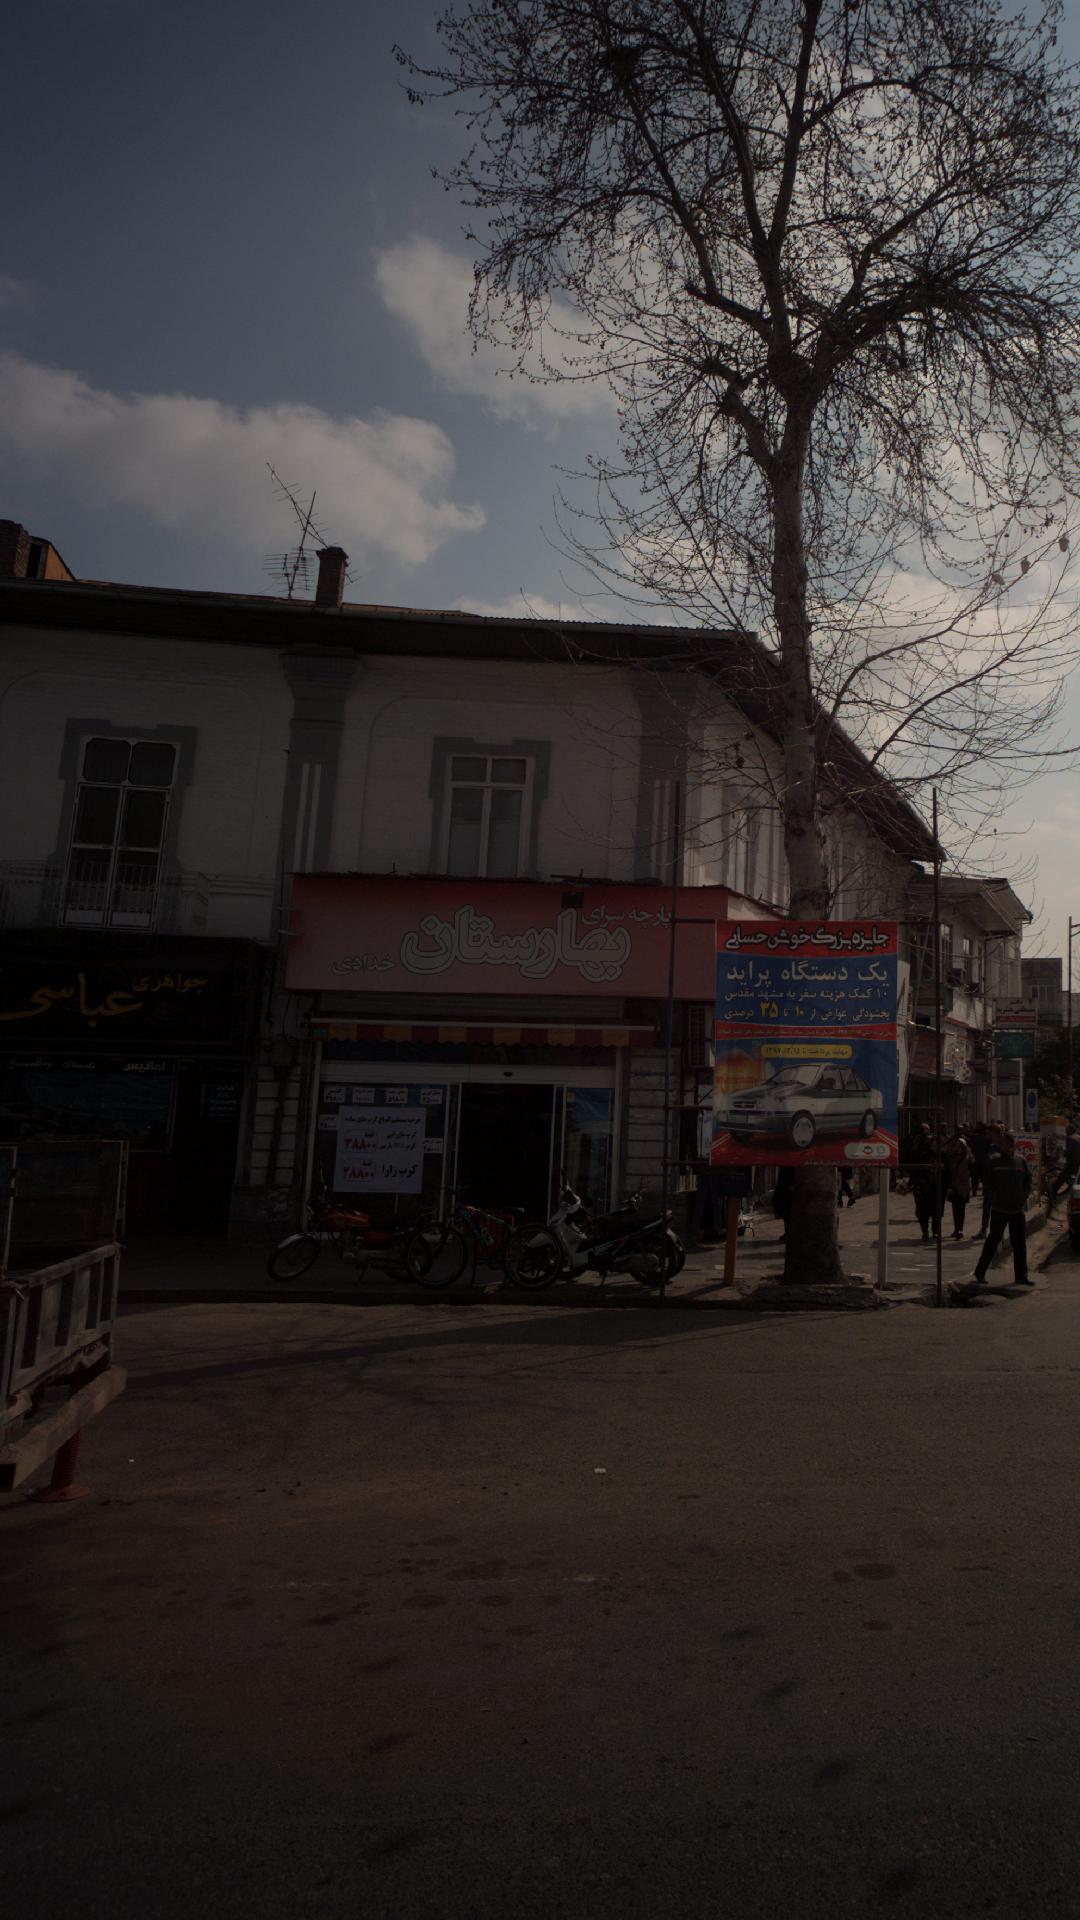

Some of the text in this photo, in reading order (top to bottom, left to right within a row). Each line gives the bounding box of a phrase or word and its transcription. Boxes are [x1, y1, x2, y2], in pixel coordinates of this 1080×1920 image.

[582, 905, 673, 933] پارچه سرای
[400, 904, 631, 982] بهارستان
[725, 924, 889, 952] جایزه بزرگ خوش حسابی
[727, 961, 889, 987] یک دستگاه پراید
[131, 974, 209, 993] جواهری
[0, 973, 144, 1028] عباسی
[758, 989, 784, 999] مشهد
[787, 990, 798, 1000] به
[800, 990, 817, 1002] سفر
[820, 990, 845, 1002] هزینه
[849, 988, 872, 999] کمک
[760, 1001, 779, 1018] ۳۵
[783, 1007, 789, 1017] تا
[810, 1007, 817, 1021] از
[852, 1006, 890, 1021] بخشودگی
